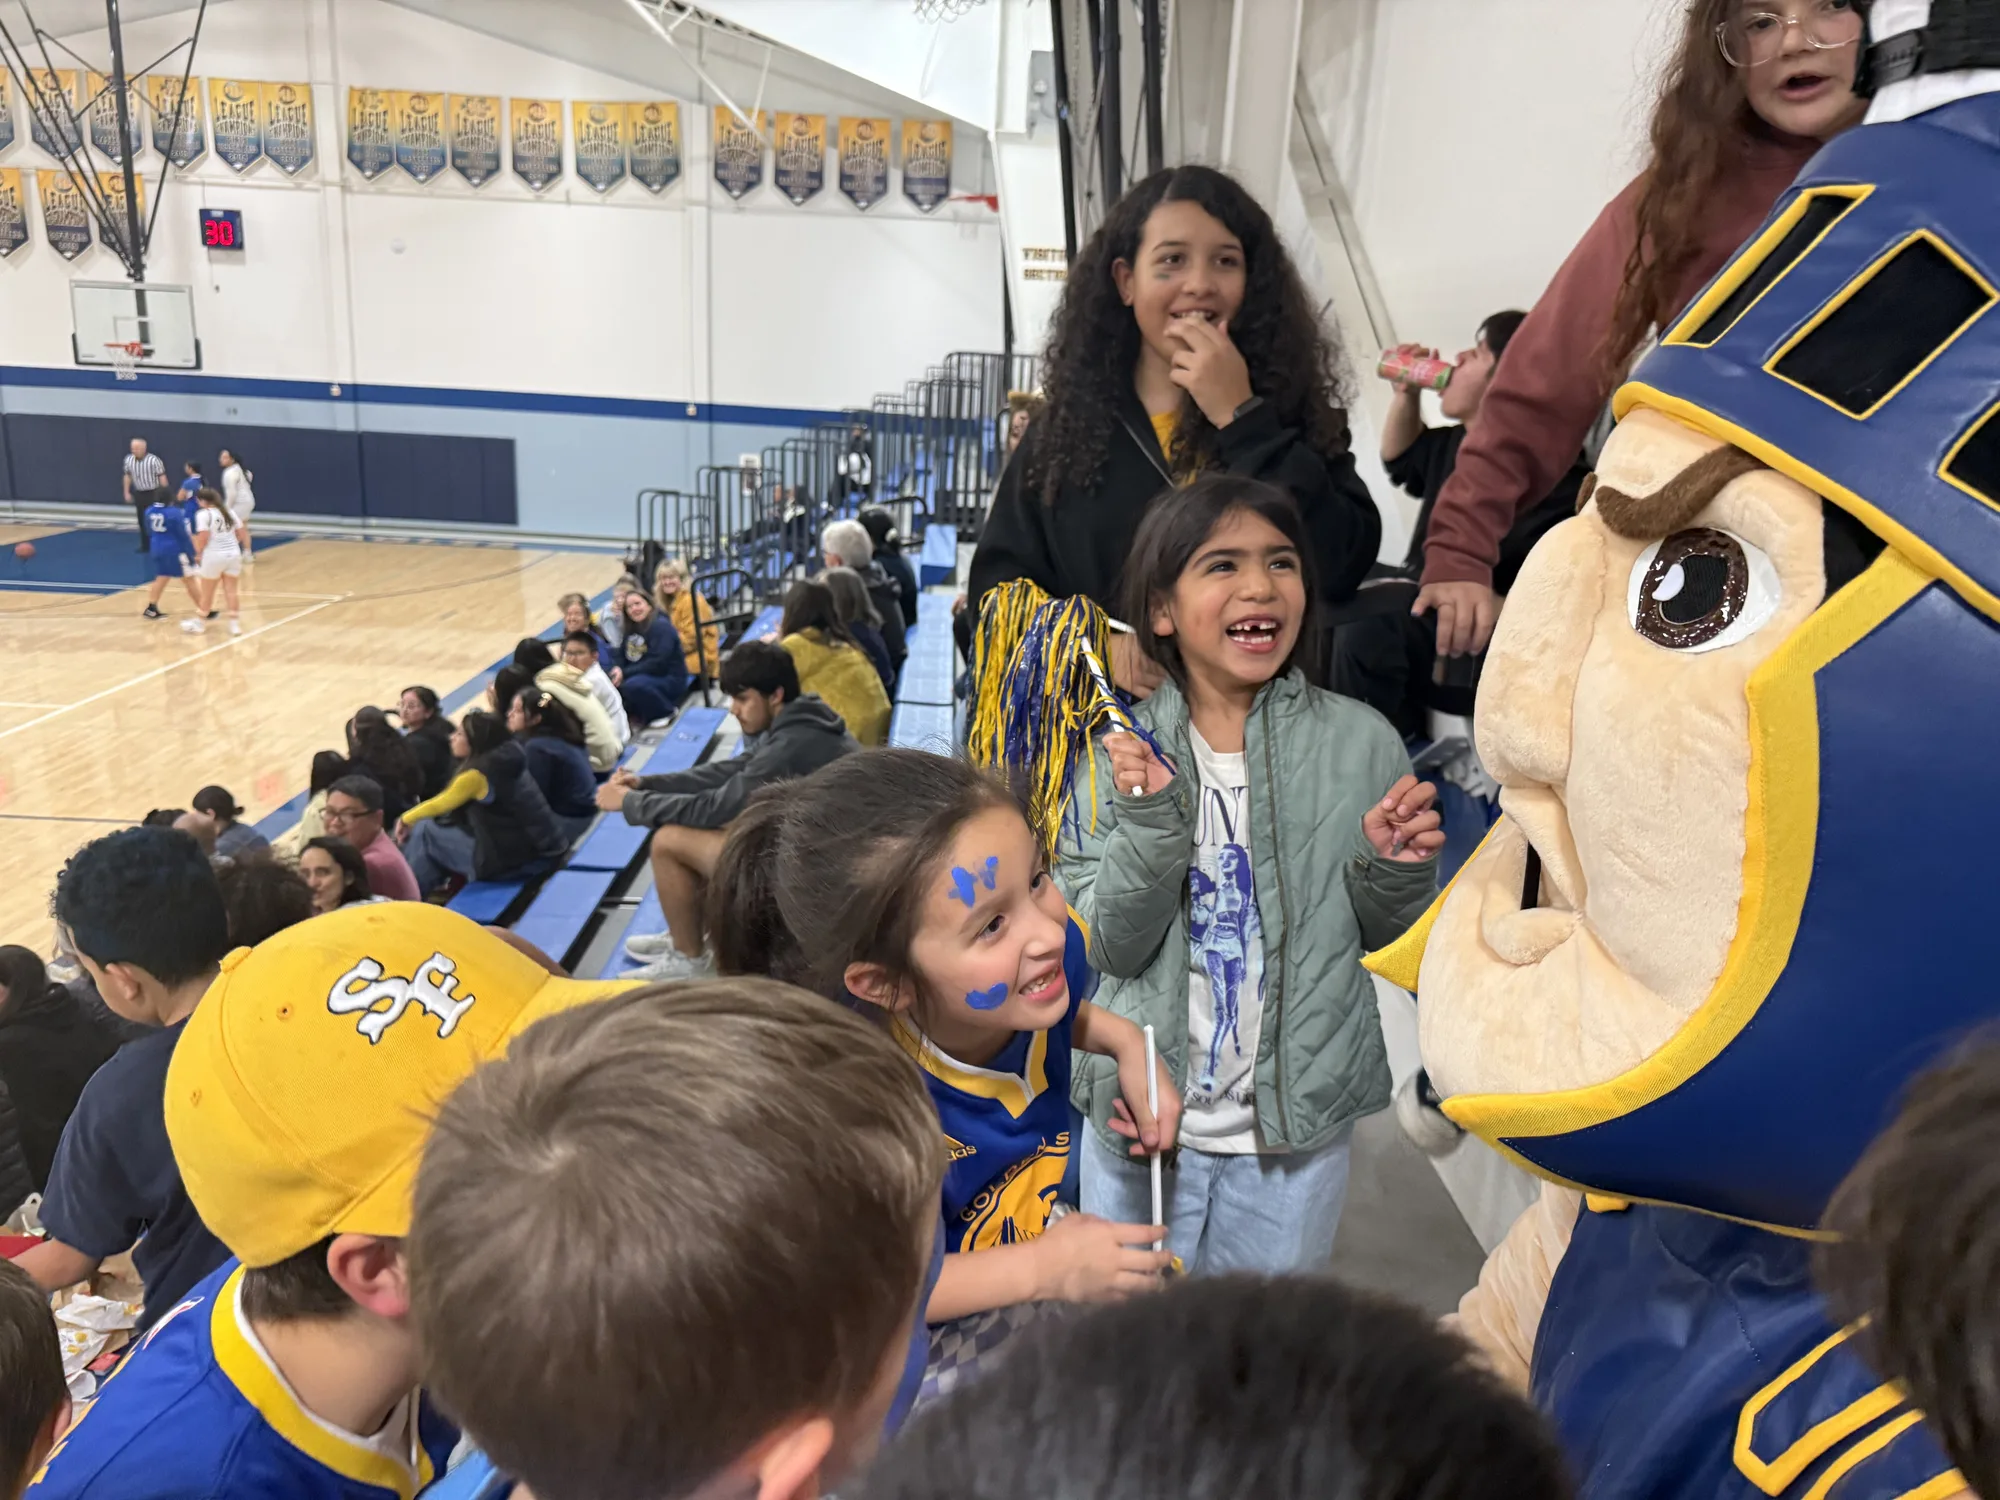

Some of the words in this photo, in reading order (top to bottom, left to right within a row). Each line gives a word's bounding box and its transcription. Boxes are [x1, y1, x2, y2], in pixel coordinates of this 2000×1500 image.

[215, 96, 256, 122] LEAGUE
[268, 100, 308, 126] LEAGUE
[352, 107, 389, 133] LEAGUE
[400, 109, 440, 136] LEAGUE
[456, 112, 496, 139] LEAGUE
[205, 220, 233, 246] 30
[150, 513, 167, 532] 22
[327, 952, 476, 1045] SF
